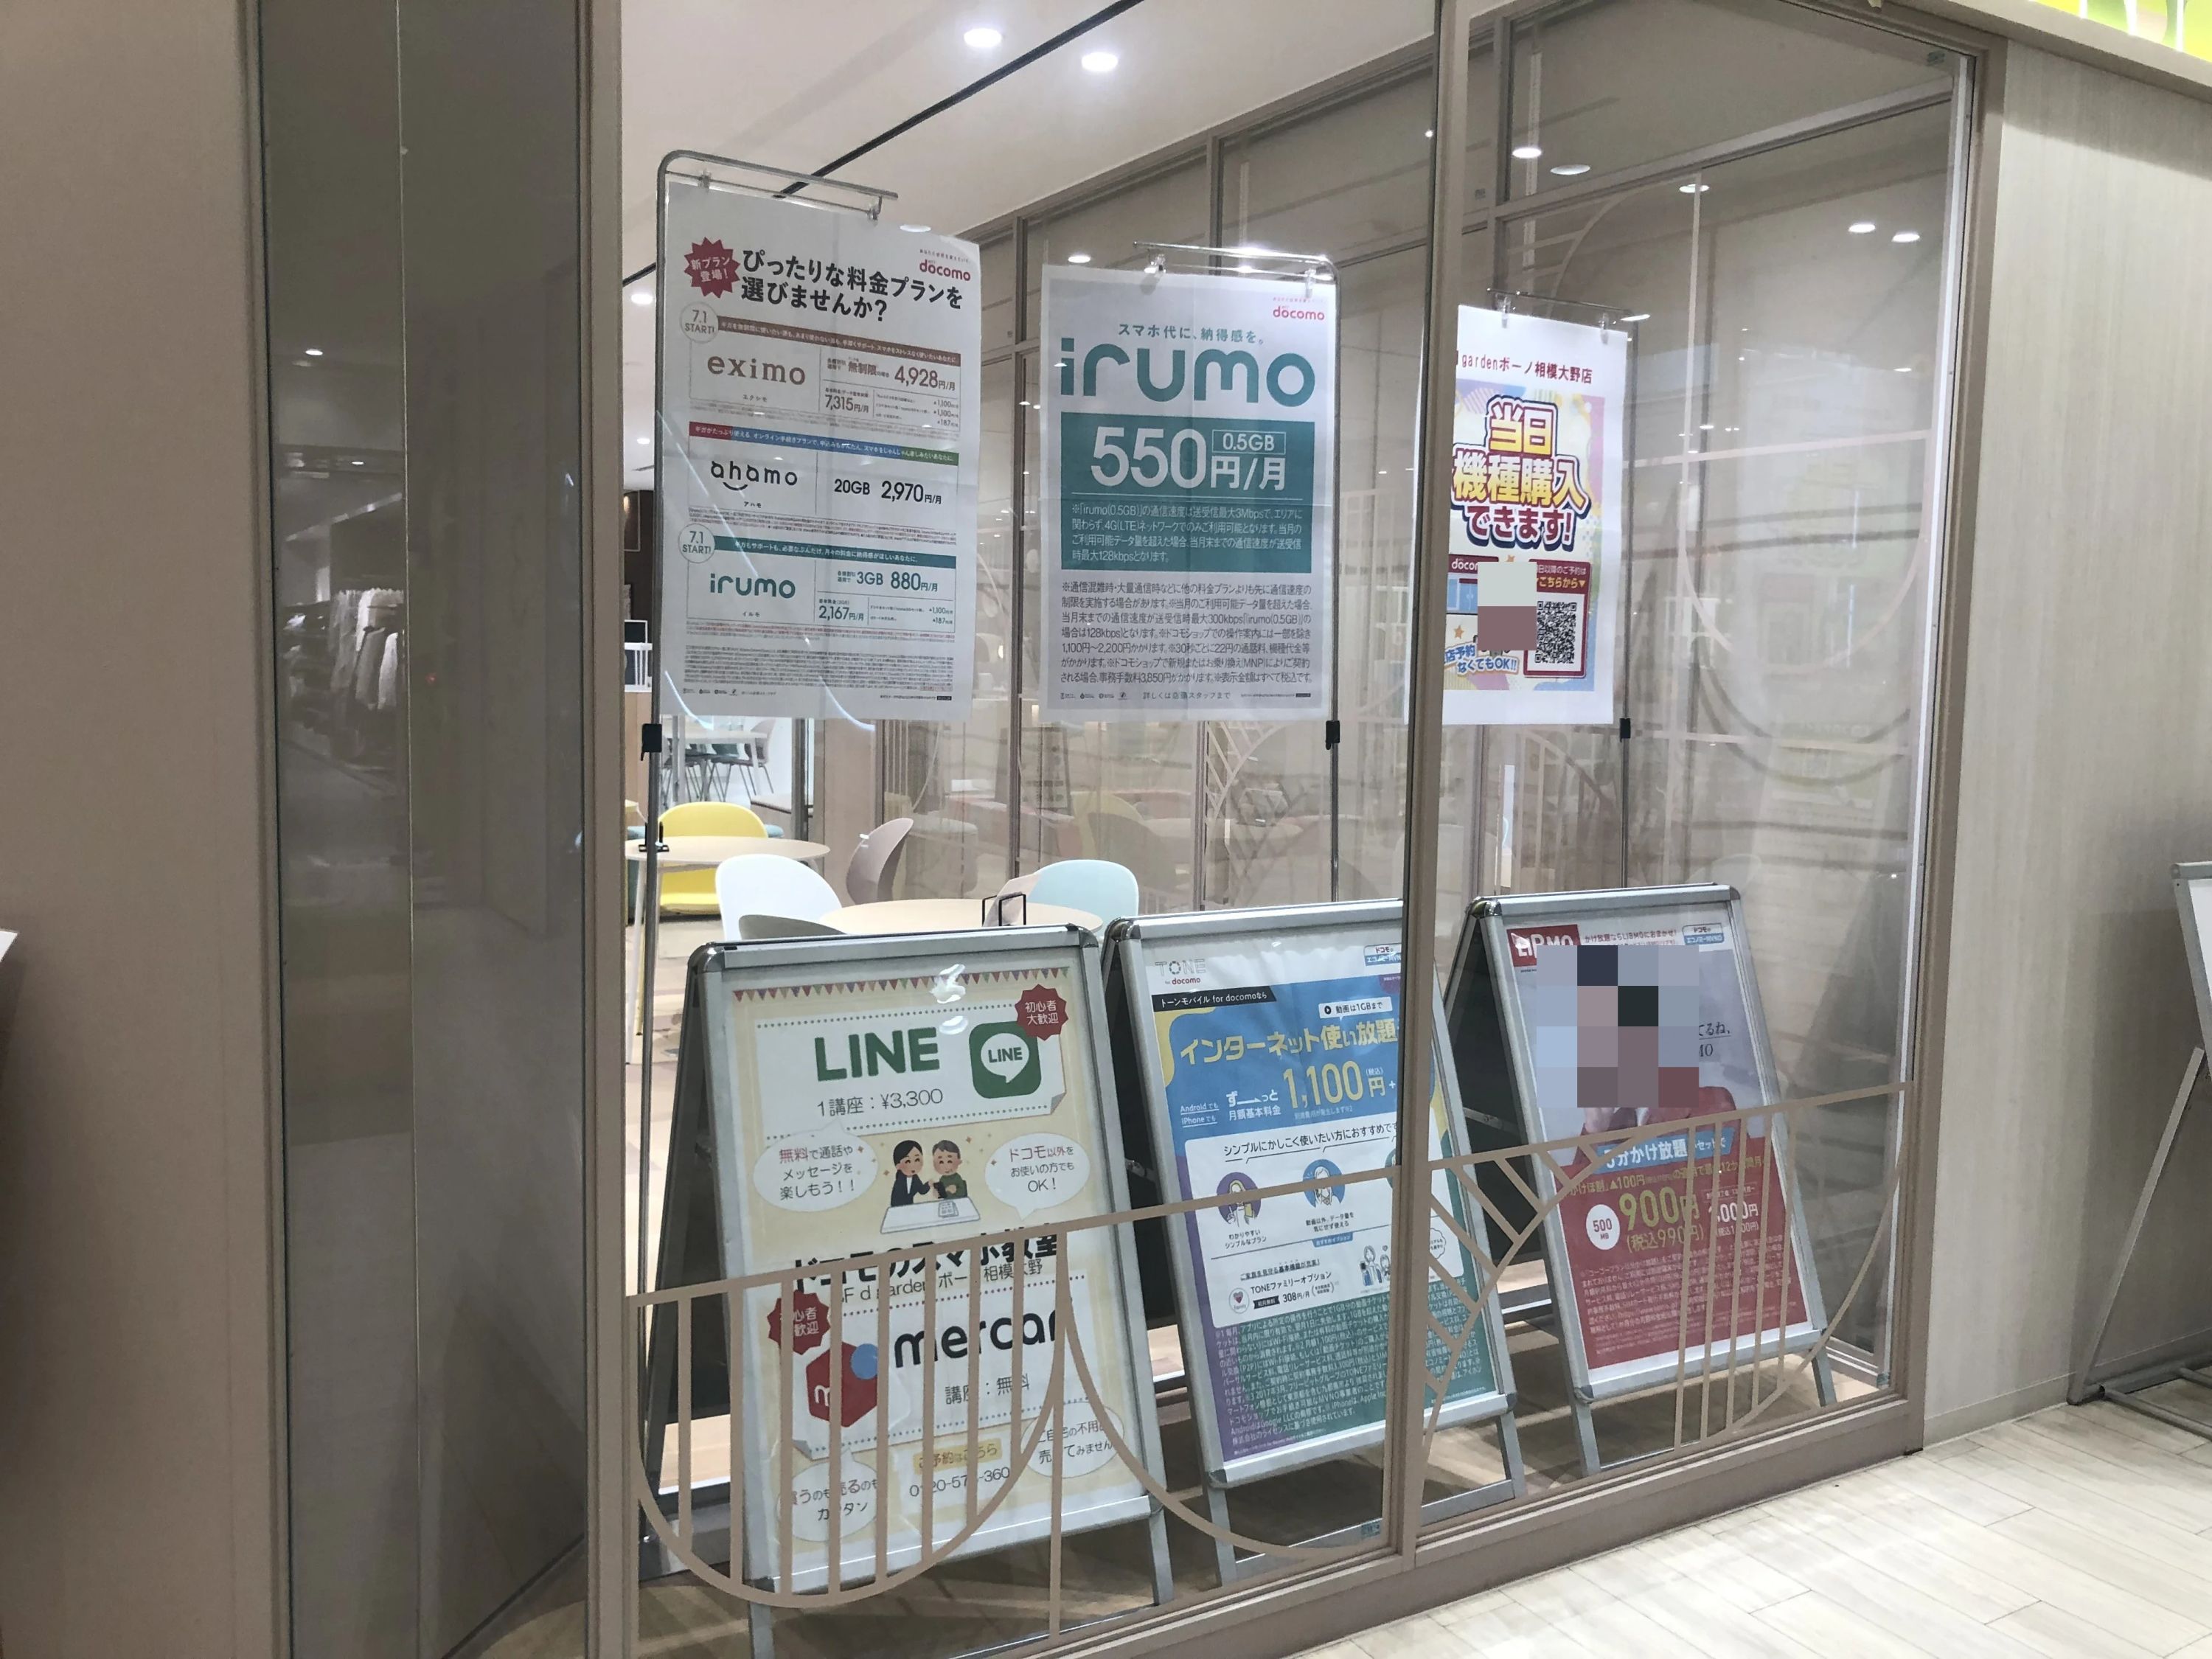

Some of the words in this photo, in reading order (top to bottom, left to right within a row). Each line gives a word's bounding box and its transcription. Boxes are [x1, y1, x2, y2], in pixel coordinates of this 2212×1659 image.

[691, 257, 730, 270] 新プラン
[919, 260, 970, 281] docomo
[743, 249, 962, 309] ぴったりな料金プランを
[692, 310, 706, 324] 7.1
[1273, 306, 1324, 320] docomo
[684, 324, 714, 335] START!
[1119, 324, 1264, 345] スマホ代に、納得感を。
[707, 355, 806, 386] eximo
[894, 365, 956, 391] 4,928円/月
[1061, 338, 1315, 407] irumo
[742, 394, 768, 403] エクシモ
[824, 394, 869, 413] 7,315円/月
[1489, 401, 1554, 455] 当日
[1222, 434, 1275, 451] 0.5GB
[1091, 426, 1286, 491] 550円/月
[710, 460, 798, 487] ahamo
[1453, 450, 1586, 510] 機種購入
[834, 479, 870, 495] 20GB
[881, 480, 942, 505] 2,970円/月
[689, 531, 704, 545] 7.1
[682, 544, 712, 555] START!
[1451, 558, 1478, 570] doco
[1536, 564, 1587, 577] 日以降のご予約は
[709, 573, 796, 599] irumo
[857, 571, 883, 585] 3GB
[891, 571, 938, 592] 880円/月
[819, 605, 864, 621] 2,167円/月
[1155, 959, 1206, 976] TONE
[1172, 976, 1201, 985] docomo
[1025, 1000, 1057, 1015] 初心者
[1161, 996, 1211, 1008] トーンモバイル
[1212, 995, 1223, 1003] for
[1225, 992, 1267, 1002] docomoなら
[1335, 1001, 1383, 1014] 動画は1GBまで
[1026, 1012, 1059, 1026] 大歓迎
[1180, 1018, 1398, 1065] インターネット使い放題
[815, 1027, 940, 1082] LINE
[988, 1047, 1023, 1062] LINE
[1180, 1104, 1207, 1112] Android
[1229, 1106, 1281, 1121] 月額基本料金
[1181, 1116, 1205, 1124] iPhone
[779, 1144, 853, 1164] 無料で通話や
[1009, 1144, 1074, 1161] ドコモ以外を
[782, 1162, 853, 1181] メッセージを
[1010, 1161, 1074, 1178] お使いの方でも
[1229, 1229, 1261, 1239] わかりやすい
[1593, 1219, 1613, 1232] 500
[1225, 1237, 1267, 1249] シンプルなプラン
[1251, 1271, 1332, 1293] TONEファミリーオプション
[818, 1502, 869, 1521] カタン
